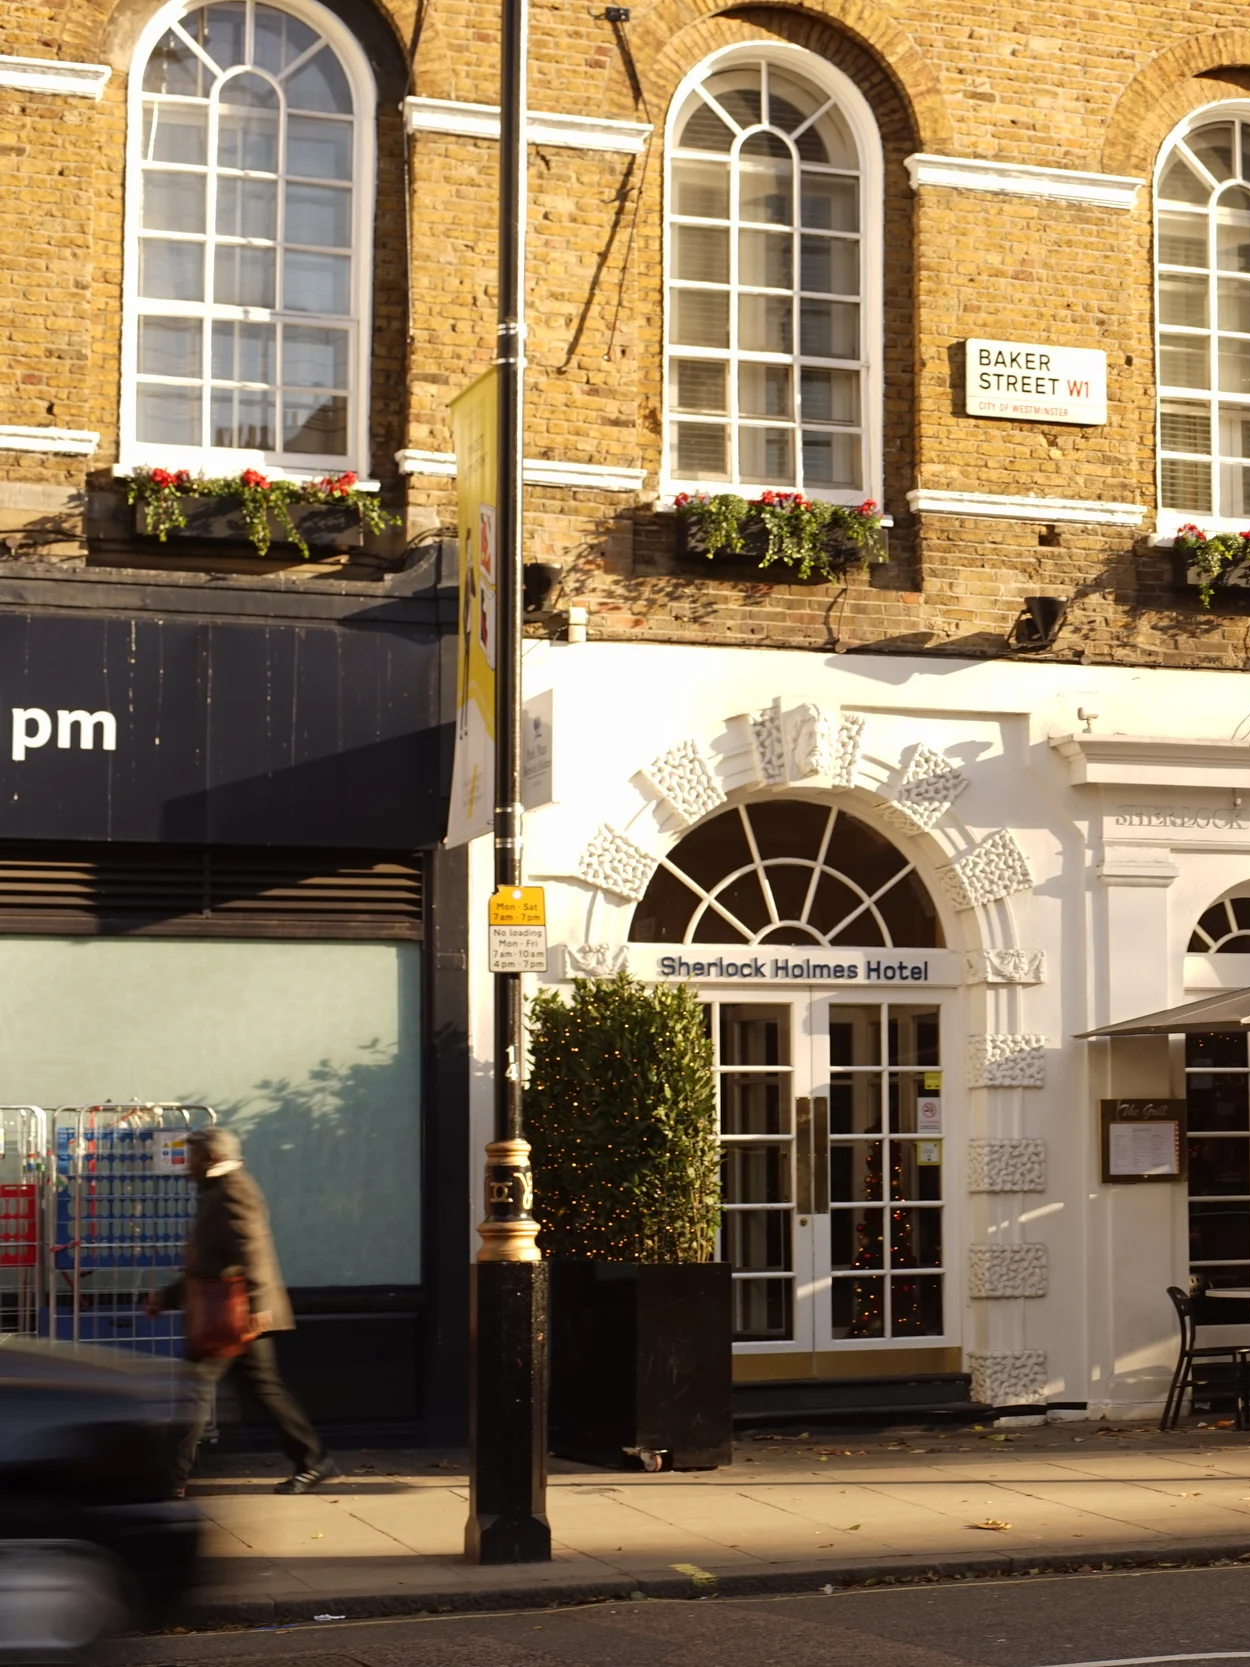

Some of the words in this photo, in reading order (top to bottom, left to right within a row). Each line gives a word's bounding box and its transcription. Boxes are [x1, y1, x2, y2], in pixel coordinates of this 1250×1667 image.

[978, 348, 1051, 371] BAKER
[978, 372, 1060, 395] STREET
[1067, 379, 1089, 398] W1
[978, 401, 996, 412] CITY
[1000, 403, 1009, 412] OF
[1012, 404, 1069, 417] WESTMINSTER
[12, 707, 117, 761] pm
[1115, 804, 1248, 829] SHERLOCK
[523, 903, 538, 911] Sat
[509, 929, 542, 938] loading
[660, 956, 766, 978] Sherlock
[774, 958, 858, 980] Holmes
[866, 960, 929, 981] Hotel
[1120, 1103, 1139, 1117] The
